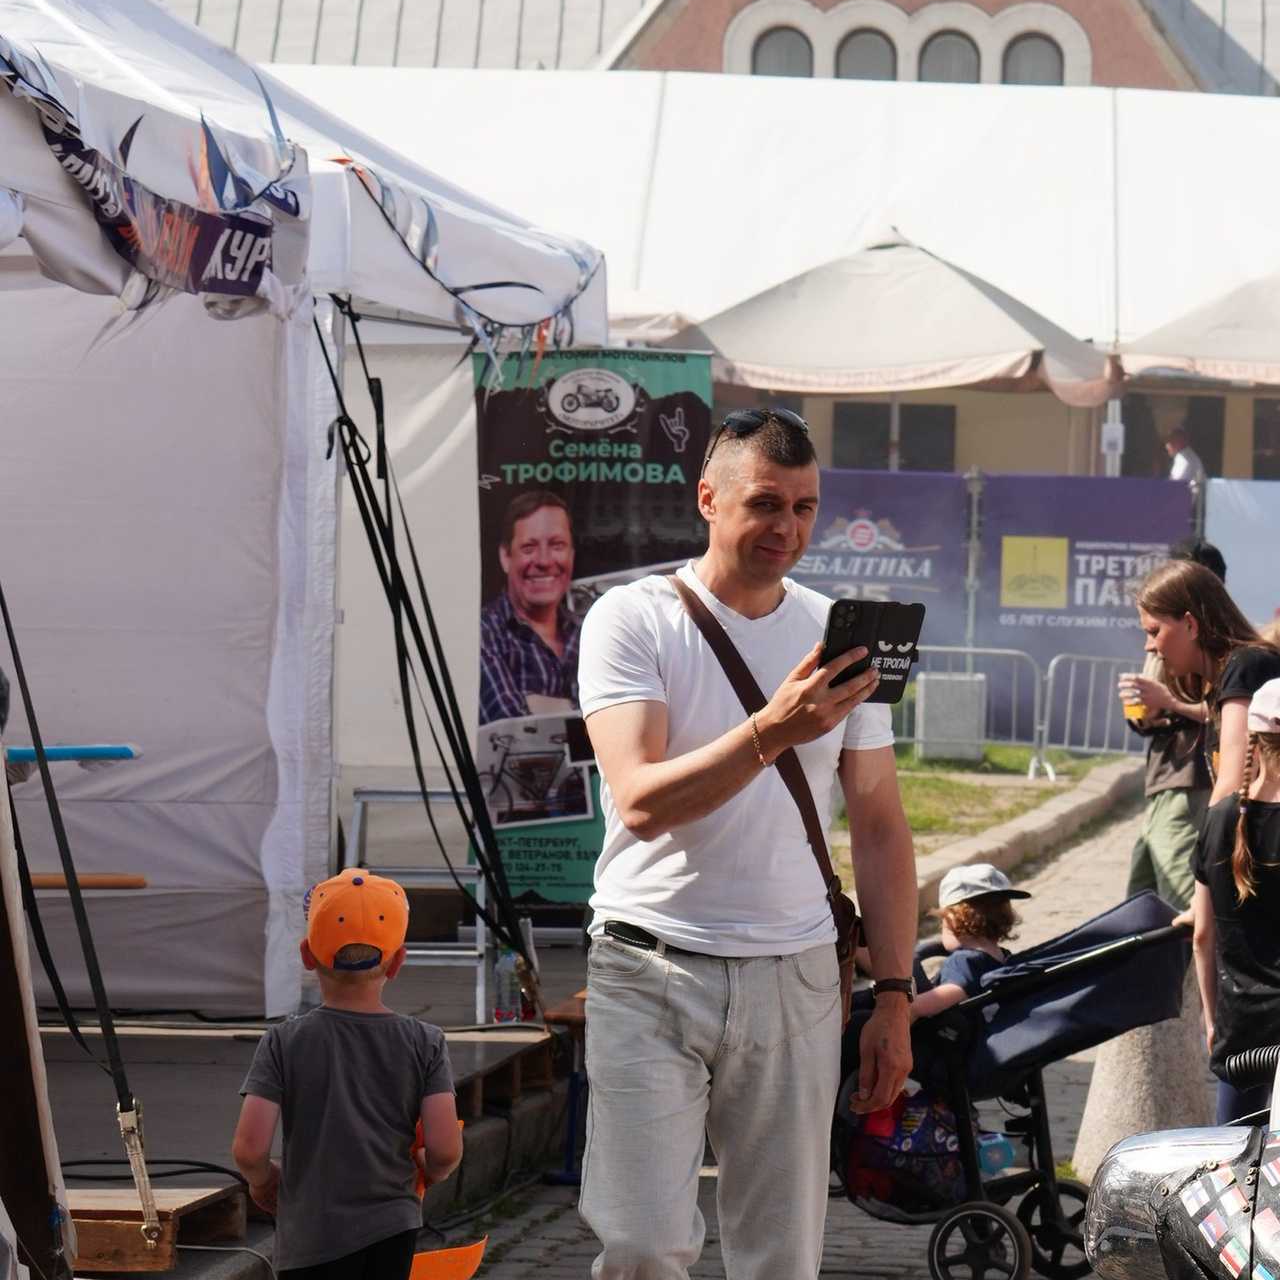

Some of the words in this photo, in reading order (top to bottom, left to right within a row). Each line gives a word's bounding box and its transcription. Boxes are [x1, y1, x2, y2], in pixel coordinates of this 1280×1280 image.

[548, 437, 642, 460] Семёна
[501, 463, 686, 485] ТРОФИМОВА
[811, 554, 932, 578] БАЛТИКА
[1019, 614, 1043, 626] ЛЕТ
[871, 657, 882, 668] НЕ
[883, 656, 911, 670] ТРОГАЙ
